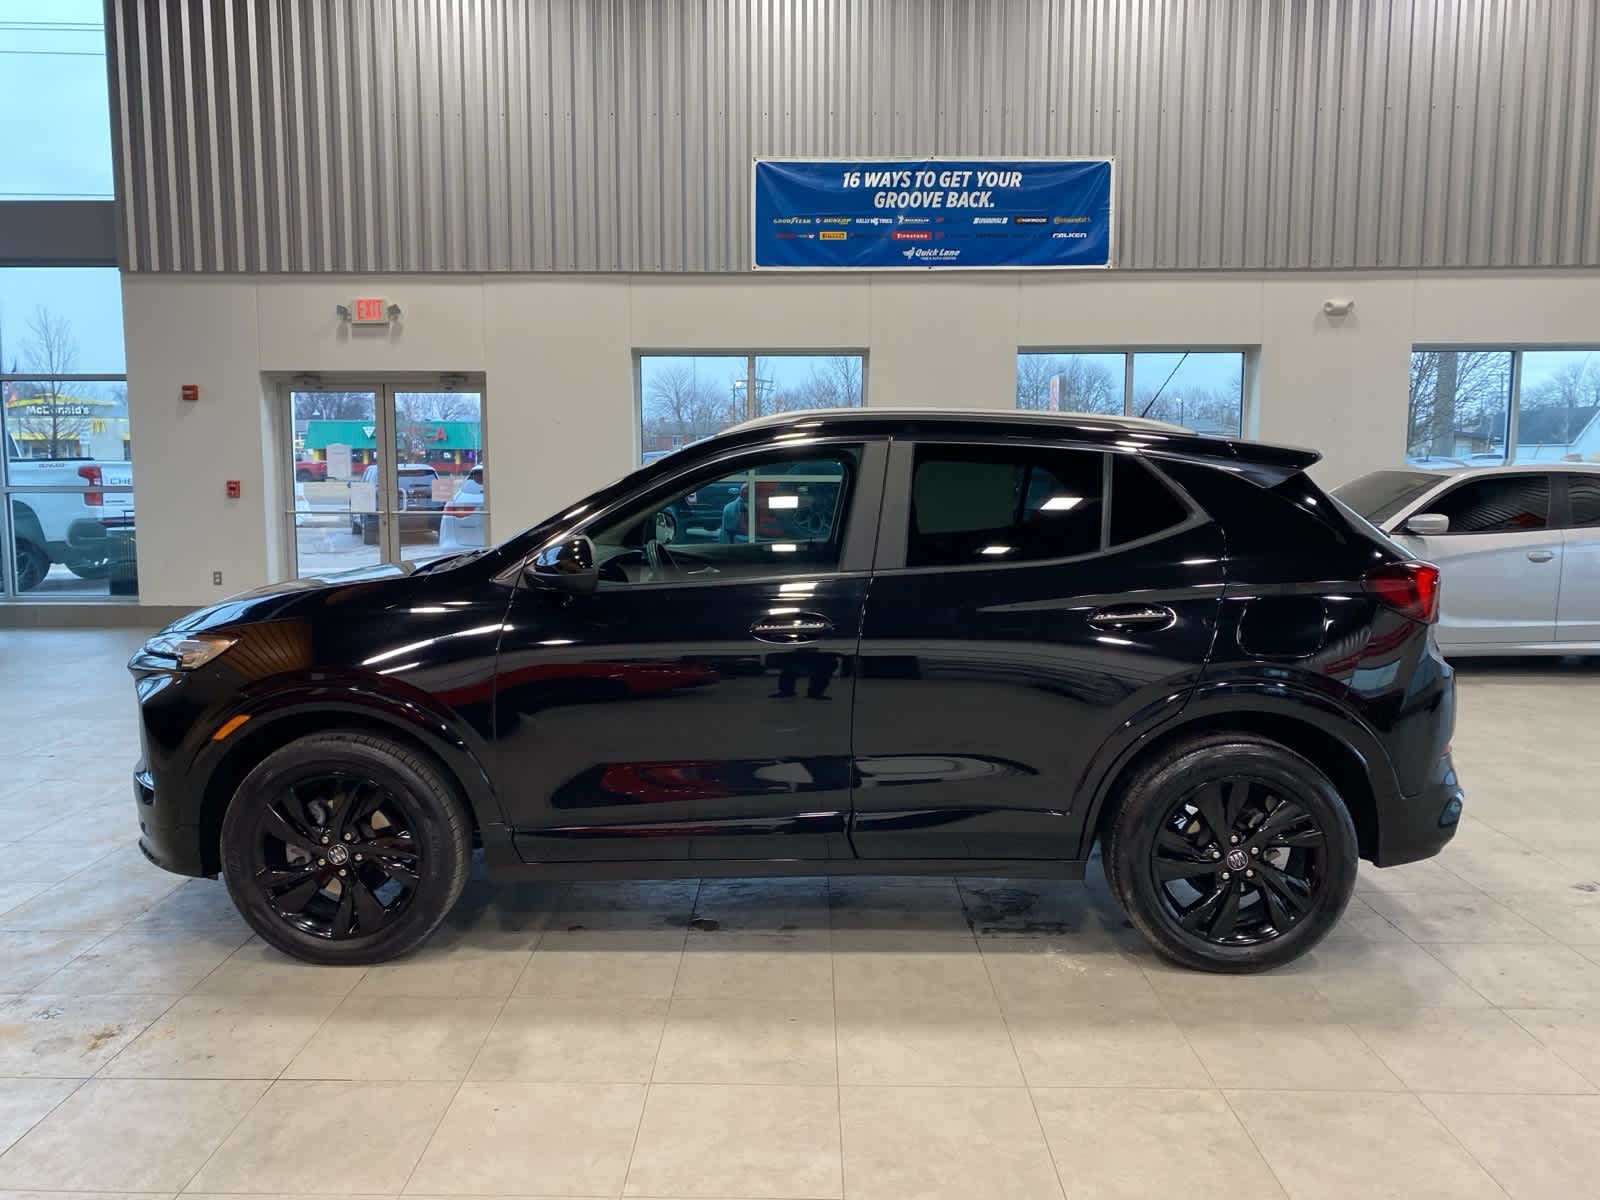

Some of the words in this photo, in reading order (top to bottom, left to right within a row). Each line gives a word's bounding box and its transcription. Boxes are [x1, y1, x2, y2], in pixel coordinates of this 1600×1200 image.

[842, 171, 860, 188] 16
[864, 171, 911, 188] WAYS
[915, 171, 936, 188] TO
[939, 171, 972, 188] GET
[976, 171, 1023, 188] YOUR
[874, 191, 943, 208] GROOVE
[946, 191, 995, 208] BACK.
[915, 248, 939, 257] Quick
[939, 248, 961, 257] Lane
[356, 299, 384, 321] EXIT
